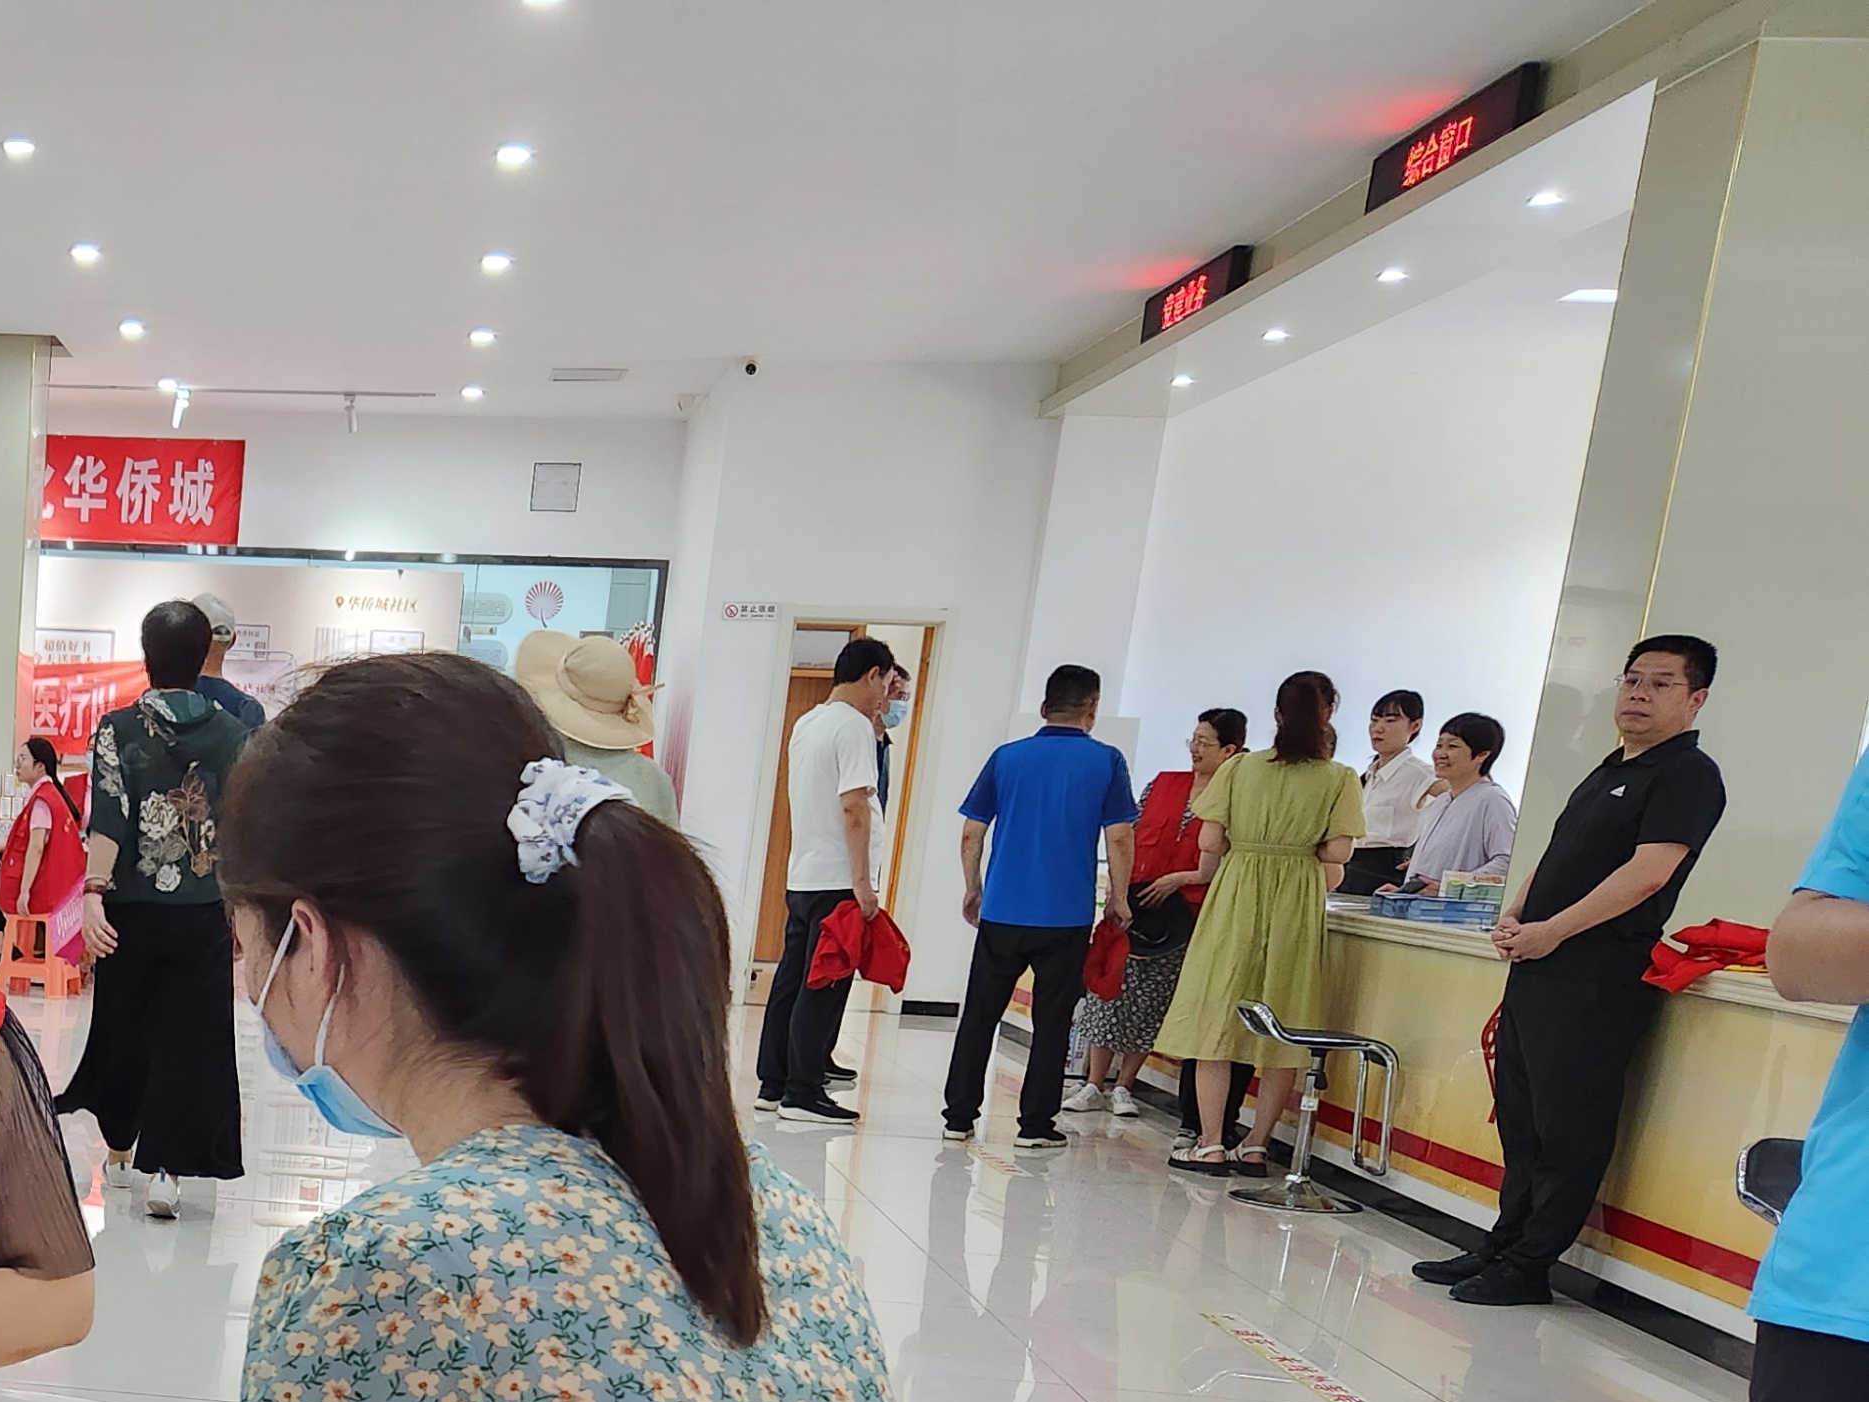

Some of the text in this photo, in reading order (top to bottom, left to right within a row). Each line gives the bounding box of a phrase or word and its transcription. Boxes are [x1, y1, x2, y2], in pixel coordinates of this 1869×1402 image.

[1401, 116, 1474, 188] 综合窗口
[42, 454, 215, 526] 华侨城
